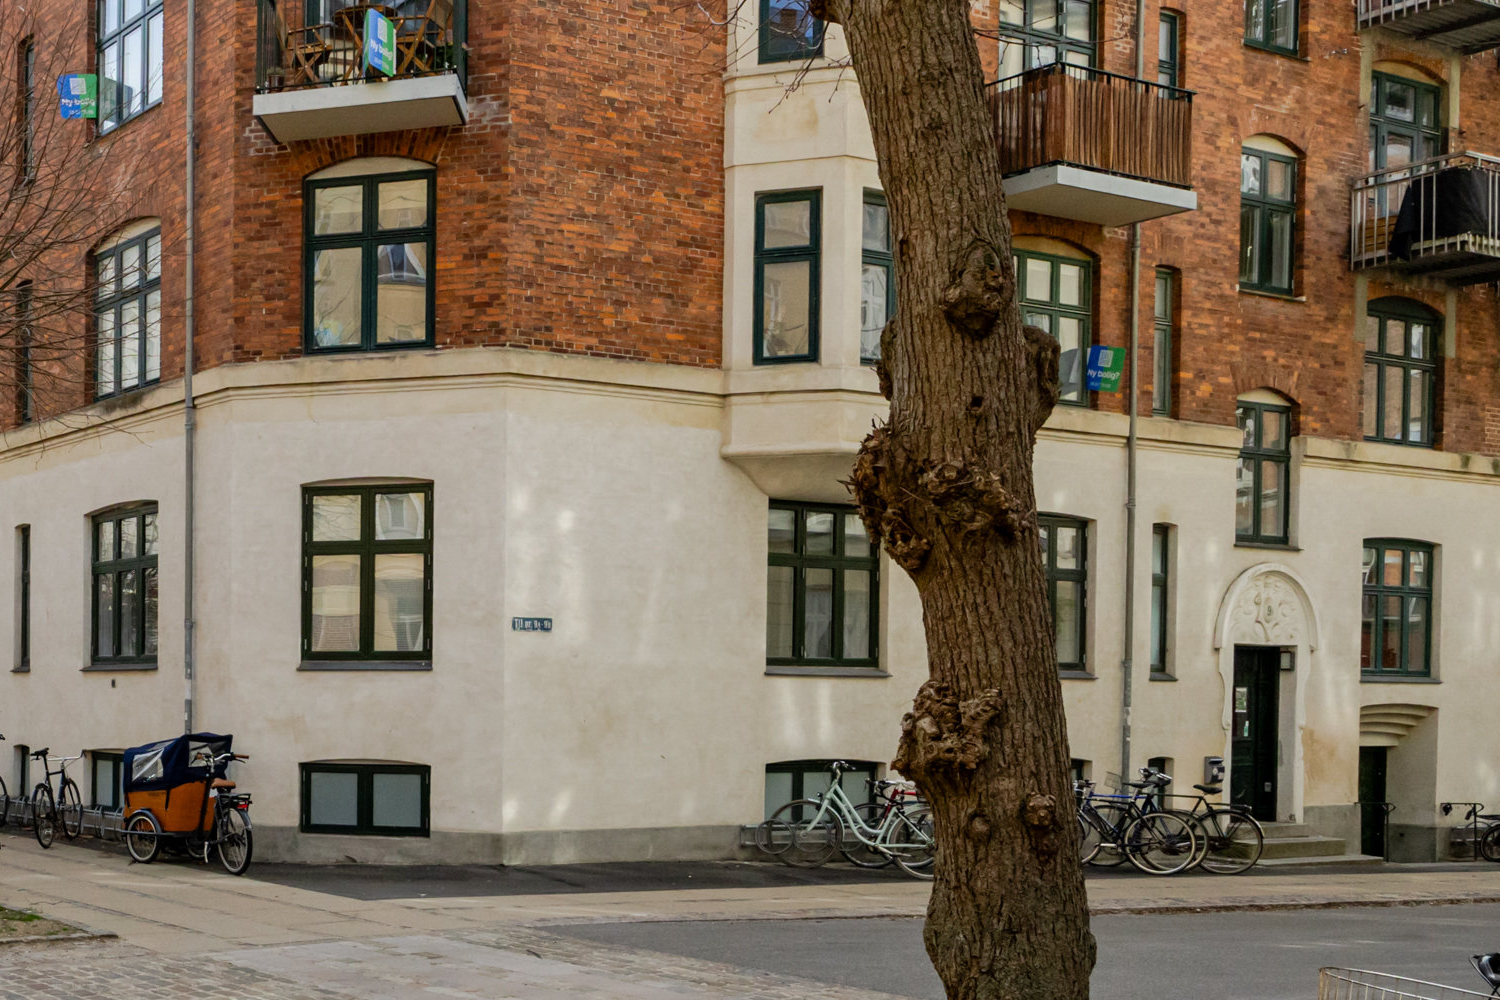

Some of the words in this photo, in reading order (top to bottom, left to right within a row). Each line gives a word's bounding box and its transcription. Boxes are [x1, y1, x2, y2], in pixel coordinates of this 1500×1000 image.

[370, 38, 378, 52] Ny
[61, 98, 73, 108] Ny
[1087, 369, 1097, 378] Ny
[1098, 370, 1120, 380] bolig?
